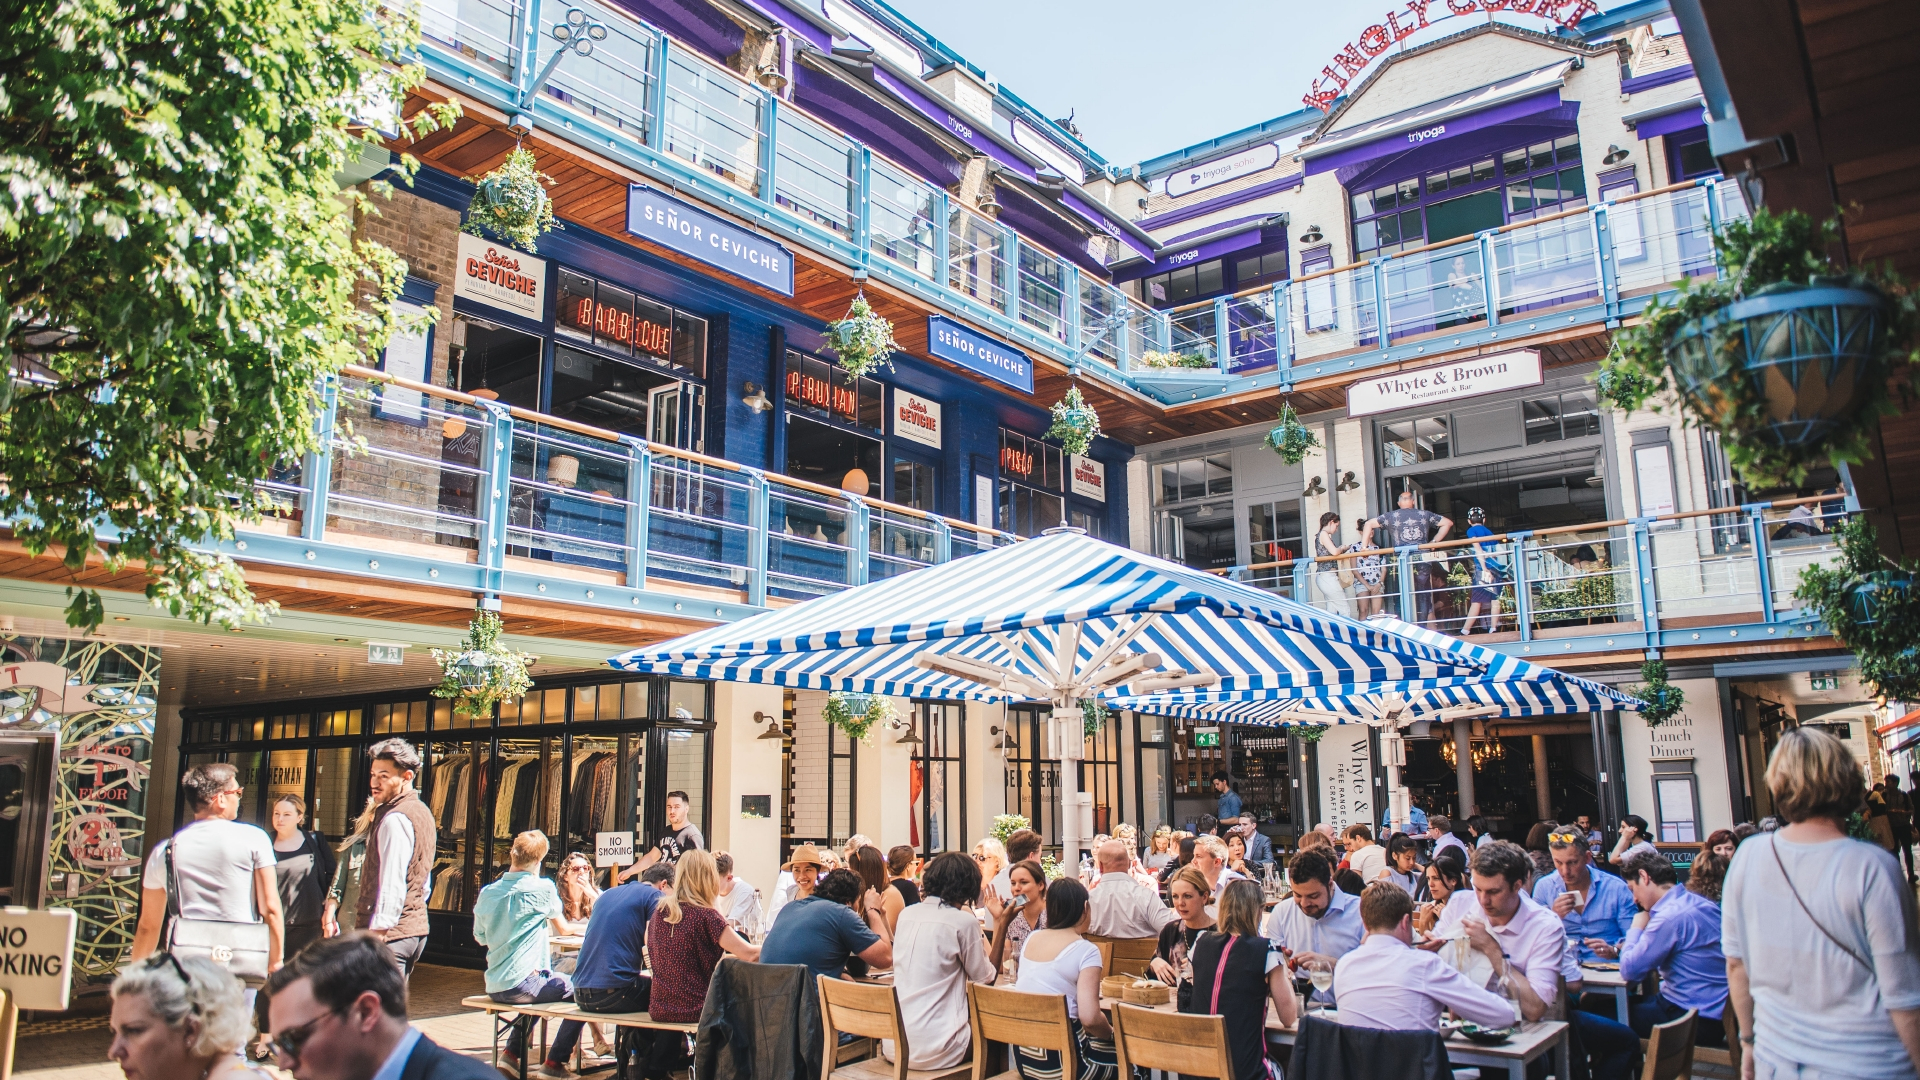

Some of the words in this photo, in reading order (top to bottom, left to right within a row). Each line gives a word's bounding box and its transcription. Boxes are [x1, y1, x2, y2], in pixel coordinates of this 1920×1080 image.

[1302, 0, 1430, 114] KINGLY
[948, 115, 972, 138] triyoga
[1408, 125, 1446, 142] triyoga
[1203, 164, 1232, 179] triyoga
[1233, 156, 1255, 170] soho
[1102, 217, 1121, 236] triyoga
[644, 205, 702, 241] SEÑOR
[709, 233, 779, 273] CEVICHE
[1169, 249, 1198, 265] triyoga
[466, 257, 536, 298] CEVICHE
[938, 329, 975, 356] SEÑOR
[978, 347, 1023, 376] CEVICHE
[1376, 378, 1428, 395] Whyte
[1433, 371, 1447, 386] &
[1453, 362, 1508, 382] Brown
[1411, 389, 1449, 400] Restaurant
[1459, 383, 1473, 391] Bar
[899, 406, 936, 431] CEVICHE
[1005, 447, 1033, 475] PISCO
[1074, 467, 1102, 488] CEVICHE
[1651, 729, 1691, 742] Lunch
[84, 745, 110, 755] LIFT
[115, 745, 131, 756] TO
[1650, 744, 1695, 757] Dinner
[267, 766, 302, 785] HERMAN
[1347, 739, 1368, 795] Whyte
[79, 788, 127, 800] FLOOR
[96, 804, 105, 815] &
[1354, 801, 1368, 814] &
[609, 836, 622, 847] NO
[73, 847, 122, 859] FLOOR
[598, 846, 633, 857] SMOKING
[0, 952, 63, 977] KING
